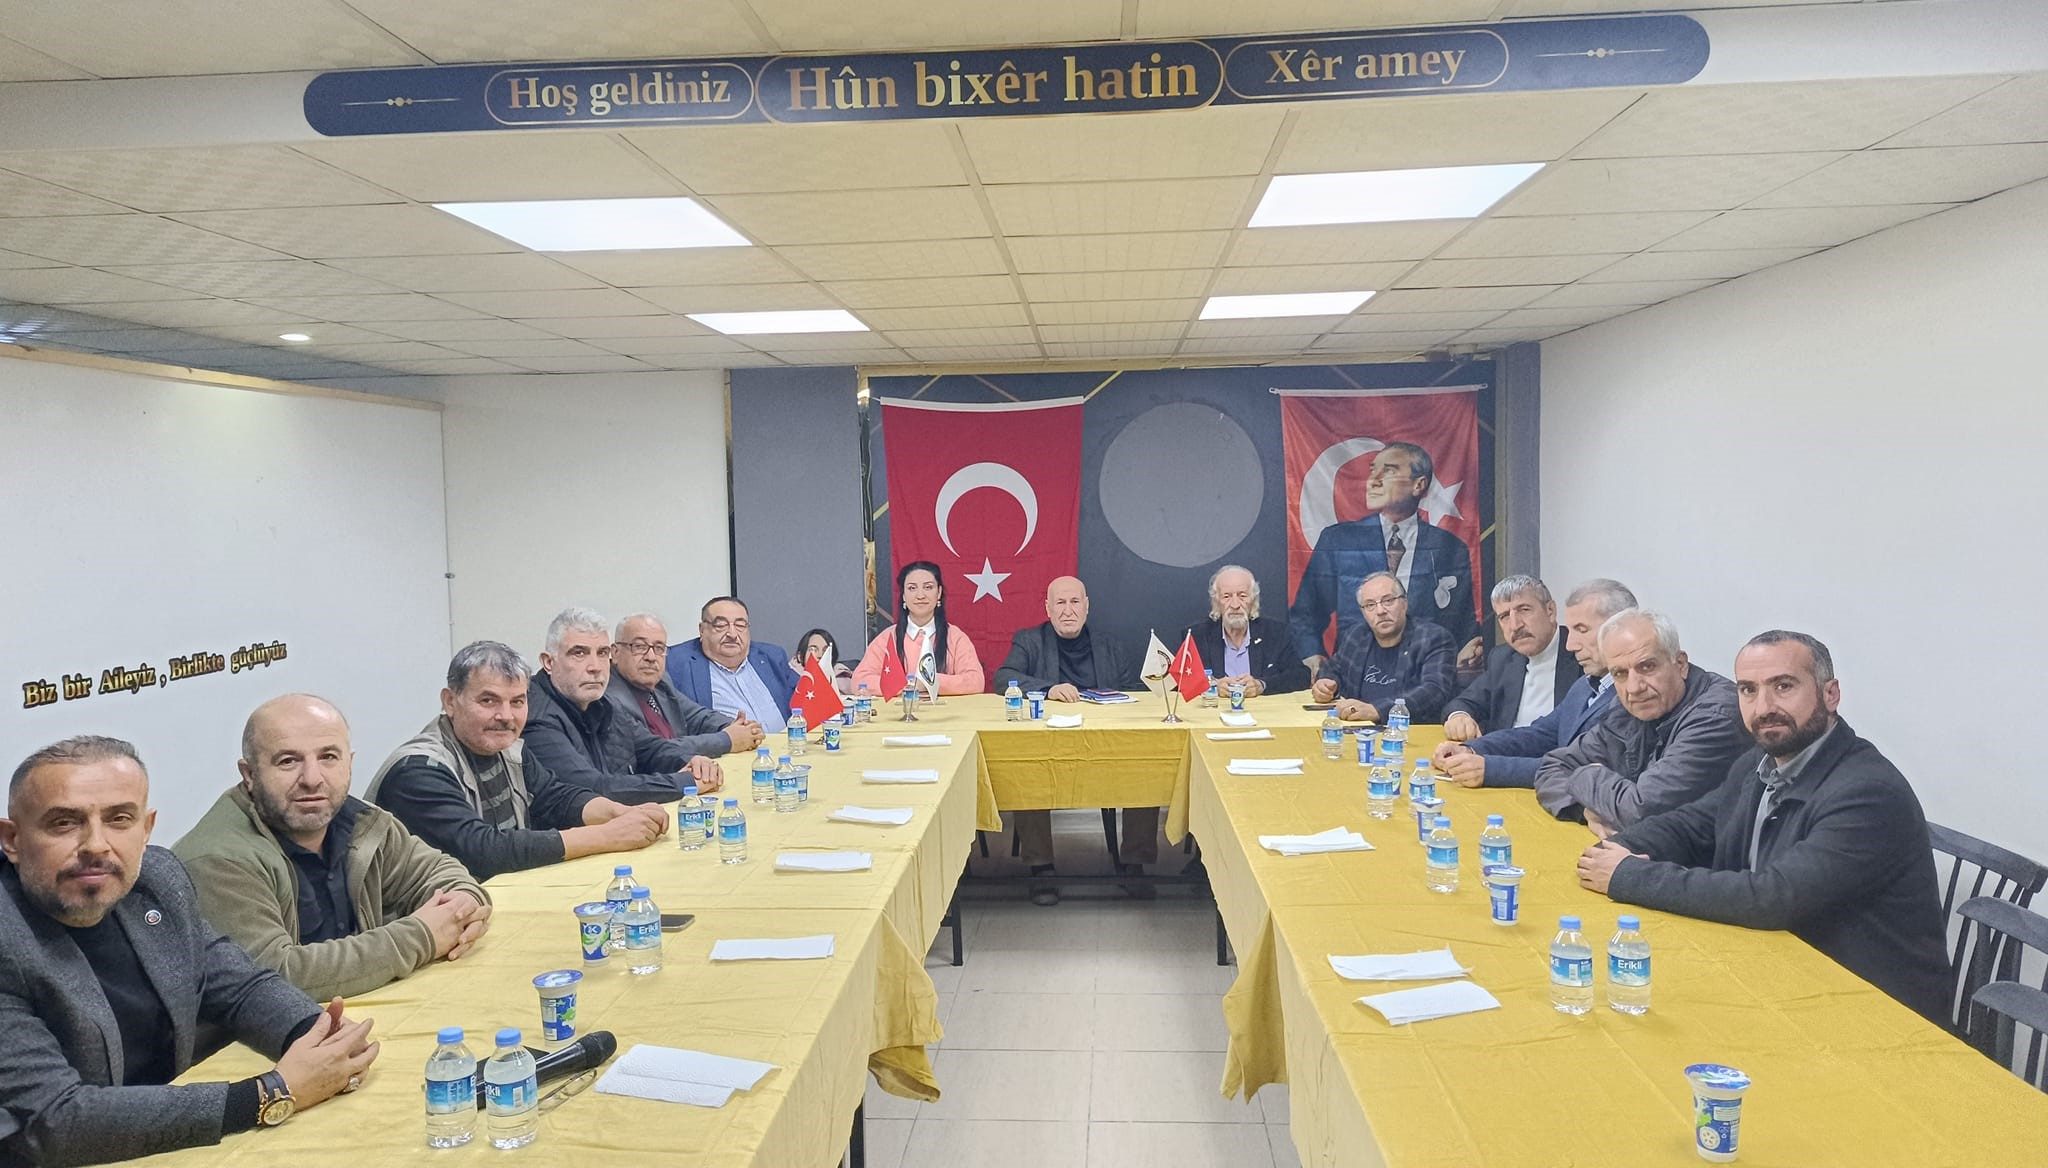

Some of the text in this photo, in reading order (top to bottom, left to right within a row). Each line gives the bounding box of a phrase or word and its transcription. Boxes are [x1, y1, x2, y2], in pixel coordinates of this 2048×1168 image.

[785, 53, 1199, 110] Hûn bixêr hatin
[1265, 49, 1466, 85] Xêr amey
[507, 71, 731, 116] Hoş geldiniz
[23, 679, 57, 708] Biz
[62, 673, 92, 701] bir
[98, 663, 156, 695] Aileyiz
[169, 651, 225, 681] Birlikte
[230, 640, 287, 673] güçlüyüz
[638, 922, 660, 935] Erikli
[1617, 959, 1643, 970] Erikli
